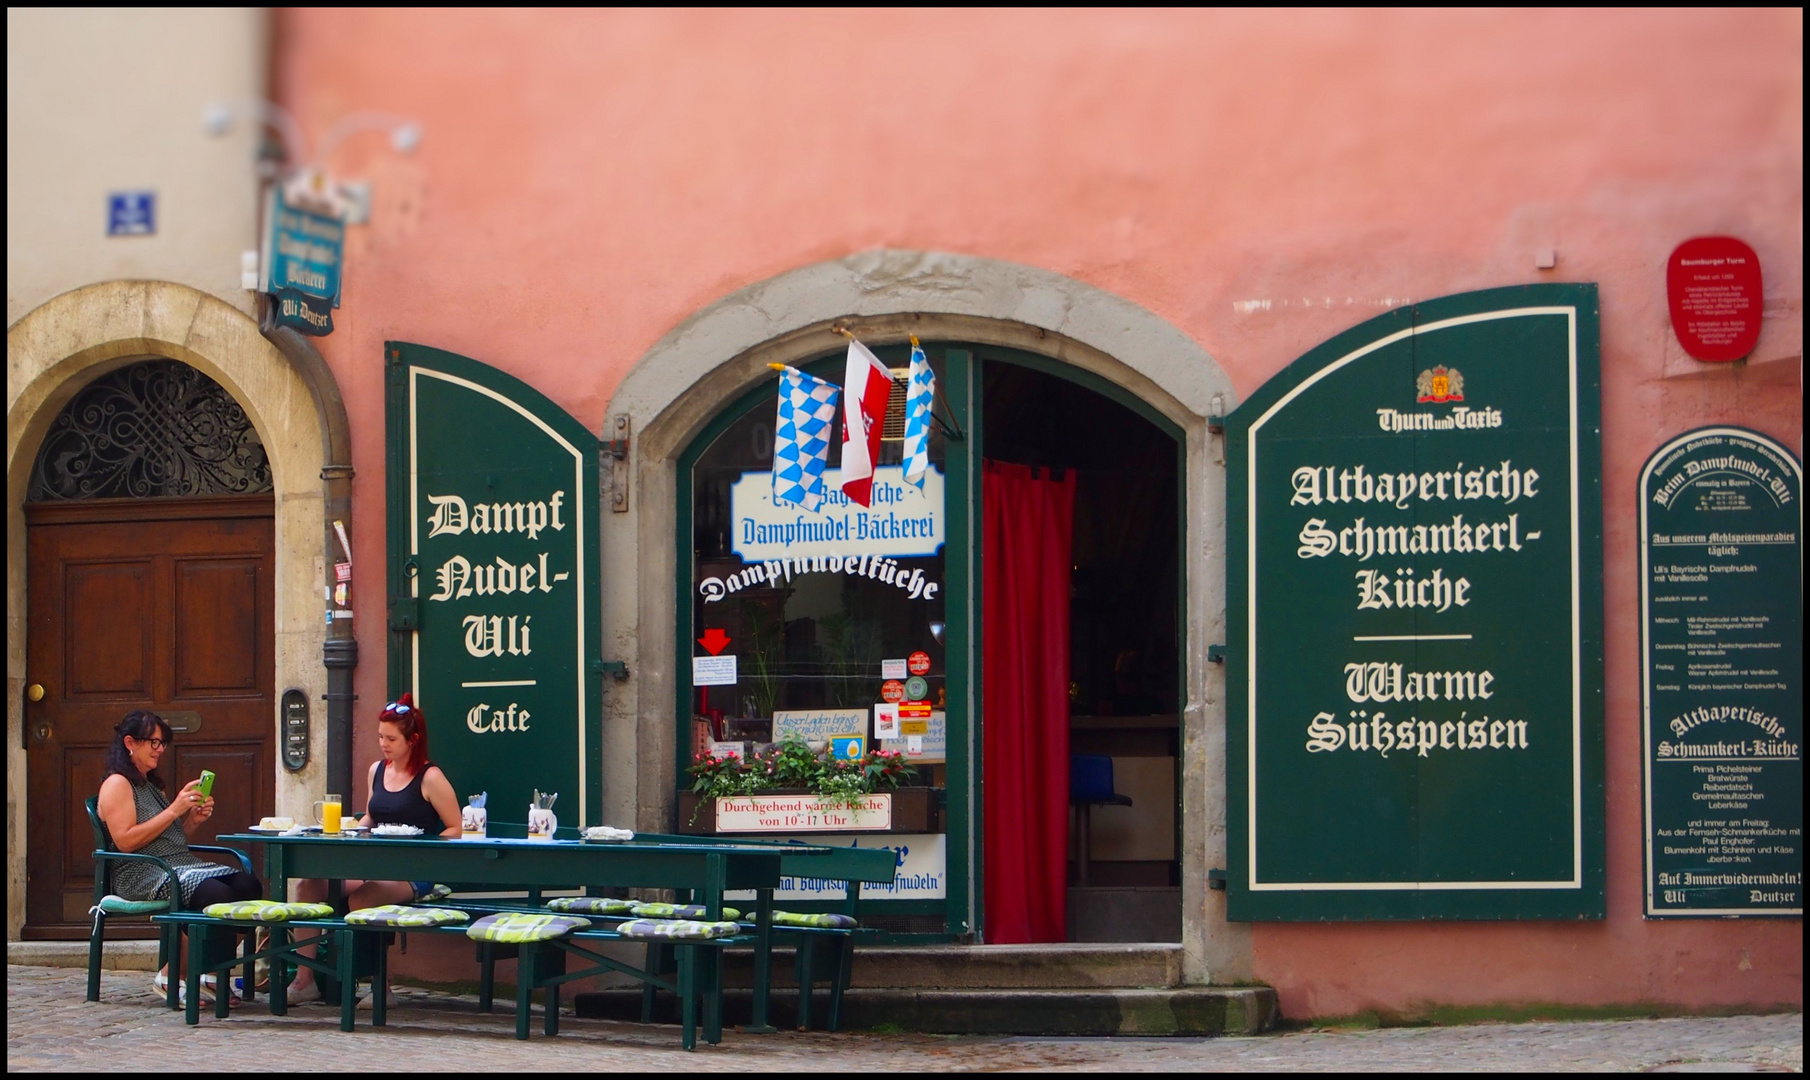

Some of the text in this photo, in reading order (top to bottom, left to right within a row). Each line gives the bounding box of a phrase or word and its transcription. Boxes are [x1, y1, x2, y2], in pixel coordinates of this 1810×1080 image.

[282, 300, 330, 330] Uli Deutzer
[1376, 406, 1503, 433] Thurn und Taxis
[1290, 460, 1540, 510] Altbayerische
[1652, 454, 1793, 508] Beim Dampfnudel-Uli
[427, 490, 566, 540] Dampf
[741, 512, 934, 547] Dampfnudel-Bäckerei
[1297, 513, 1541, 561] Schmankerl-
[429, 552, 569, 601] Nudel-
[699, 551, 939, 604] Dampfnudelküche
[1709, 564, 1757, 574] Dampfnudeln
[1355, 568, 1471, 613] Küche
[462, 614, 532, 658] Uli
[1343, 661, 1494, 702] Warme
[467, 703, 531, 734] Cafe
[1670, 706, 1785, 738] Altbayerische
[1306, 711, 1529, 758] Süßspeisen
[1658, 740, 1798, 758] Schmankerl-Küche
[1693, 765, 1763, 773] Prima Pichelsteiner
[1708, 774, 1748, 782] Bratwürste
[1703, 783, 1753, 791] Reiberdatschi
[724, 801, 801, 815] Durchgehend
[846, 799, 883, 811] Kche
[1708, 801, 1748, 809] Leberkäse
[759, 817, 780, 826] von
[823, 815, 847, 826] Uhr
[1674, 828, 1686, 836] der
[1721, 846, 1755, 854] Schinken
[1774, 846, 1794, 854] Käse
[1658, 872, 1801, 886] Auf Immerwiedernudeln!
[1664, 890, 1795, 904] Uli Deutzer
